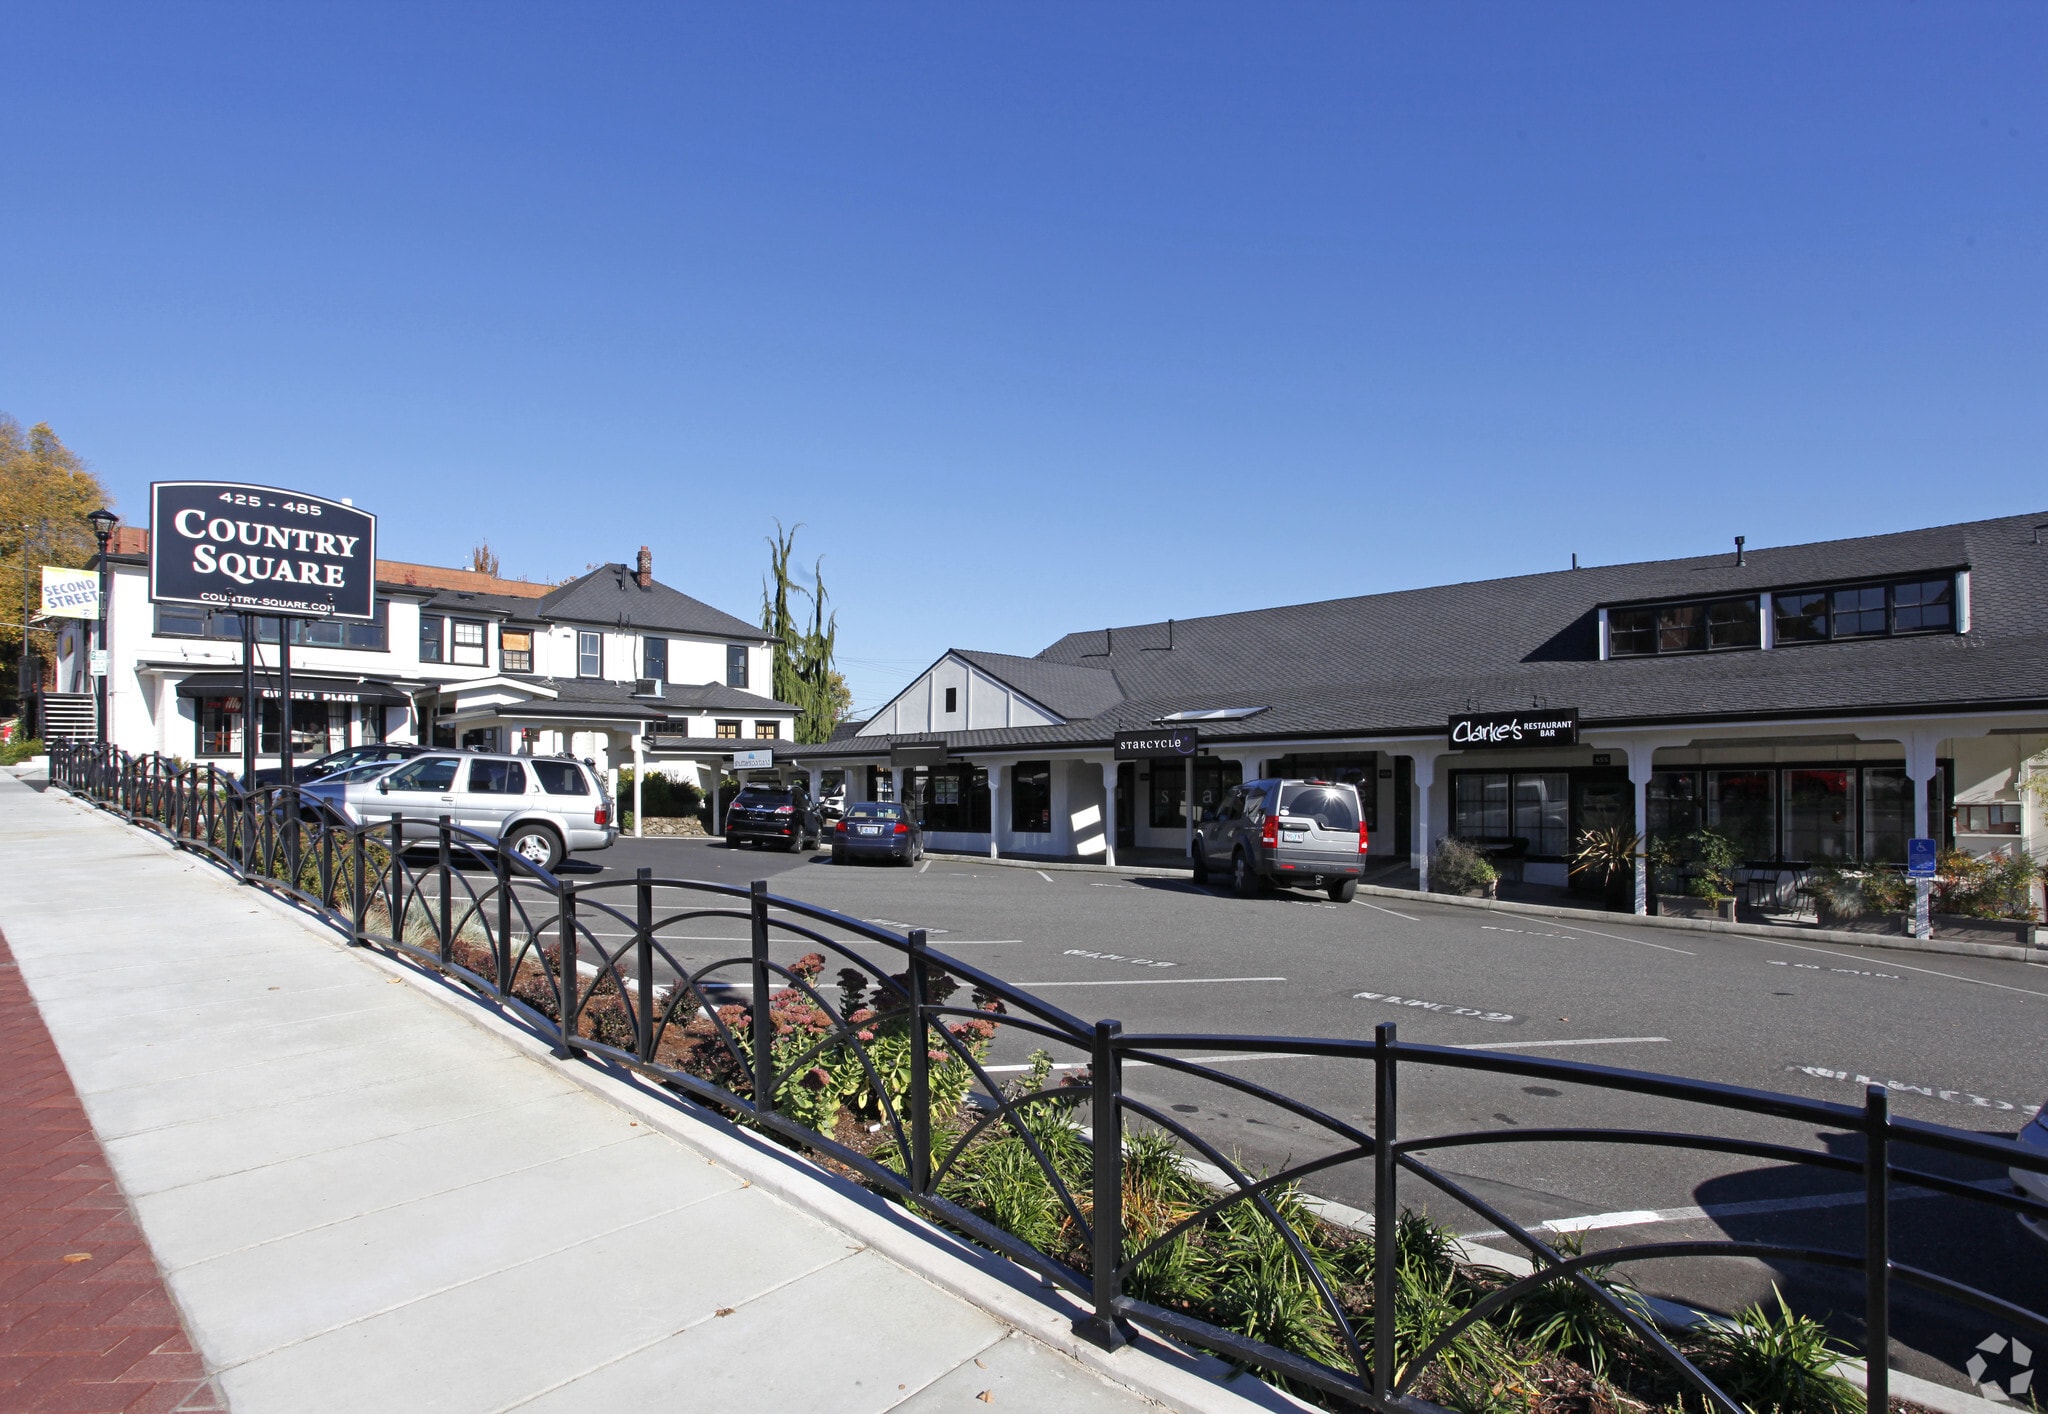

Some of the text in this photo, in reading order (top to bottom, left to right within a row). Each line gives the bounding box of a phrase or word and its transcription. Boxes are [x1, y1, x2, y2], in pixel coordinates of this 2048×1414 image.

[219, 492, 261, 507] 425
[282, 501, 322, 516] 485
[174, 508, 360, 558] COUNTRY
[192, 544, 346, 588] SQUARE
[43, 579, 96, 597] SECOND
[47, 590, 98, 609] STREET
[323, 693, 359, 702] PLACE
[1452, 719, 1523, 743] Clarke's
[1523, 720, 1573, 730] RESTAURANT
[1540, 729, 1556, 737] BAR
